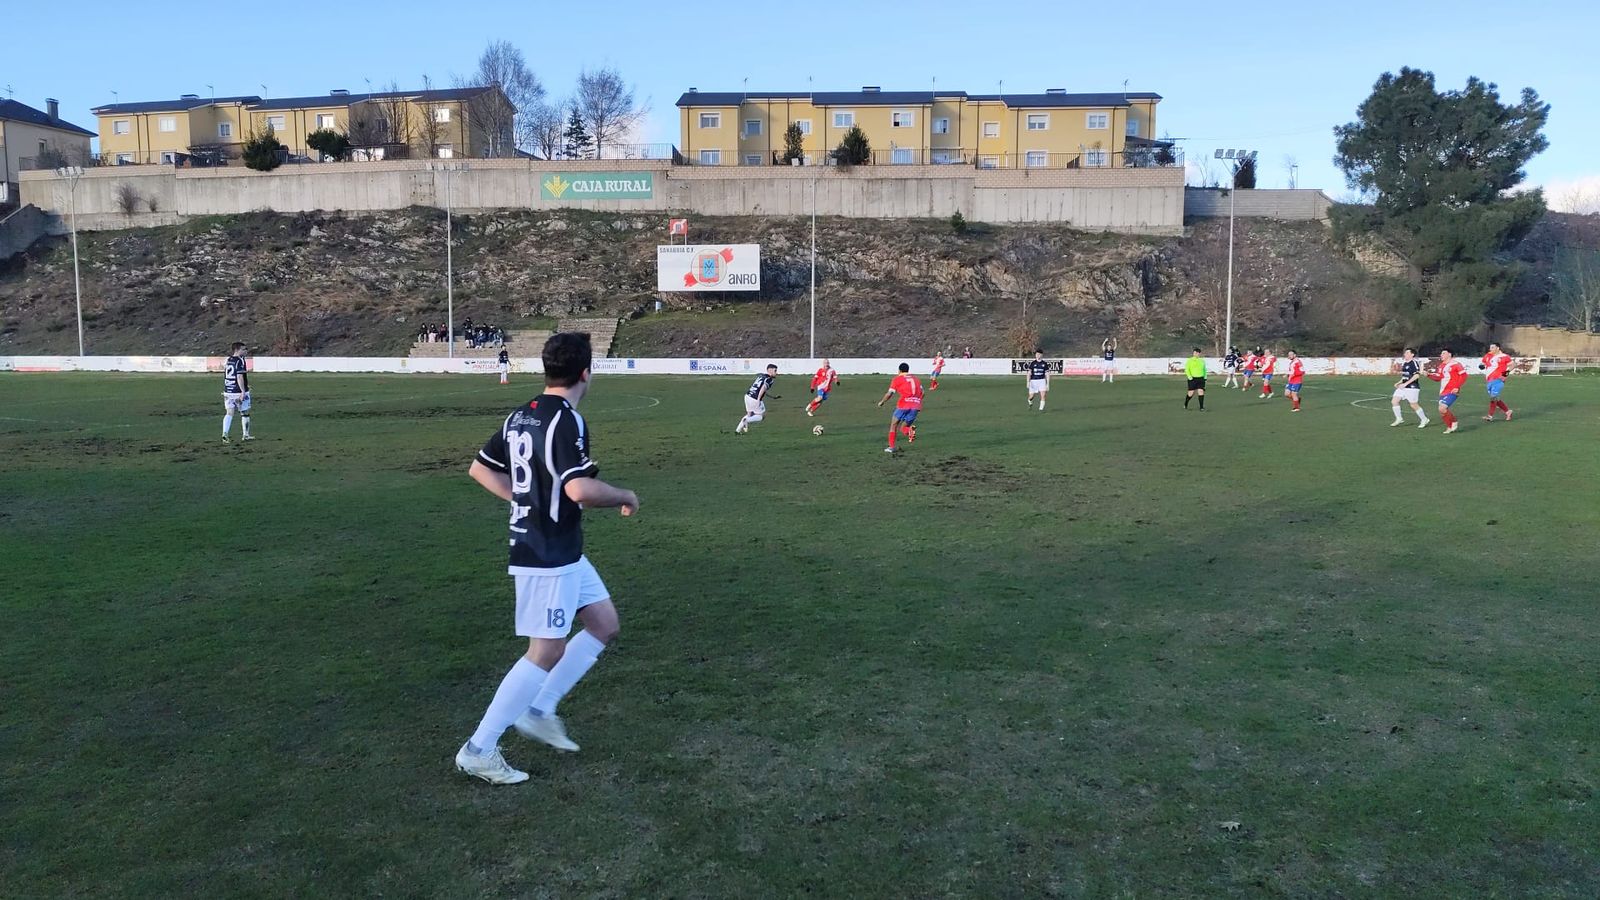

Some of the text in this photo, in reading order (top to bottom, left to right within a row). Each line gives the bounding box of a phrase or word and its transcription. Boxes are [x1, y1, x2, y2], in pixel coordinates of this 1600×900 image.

[572, 180, 651, 193] CAJA RURAL
[905, 377, 916, 396] 7
[506, 429, 533, 495] 18
[547, 608, 566, 629] 18
